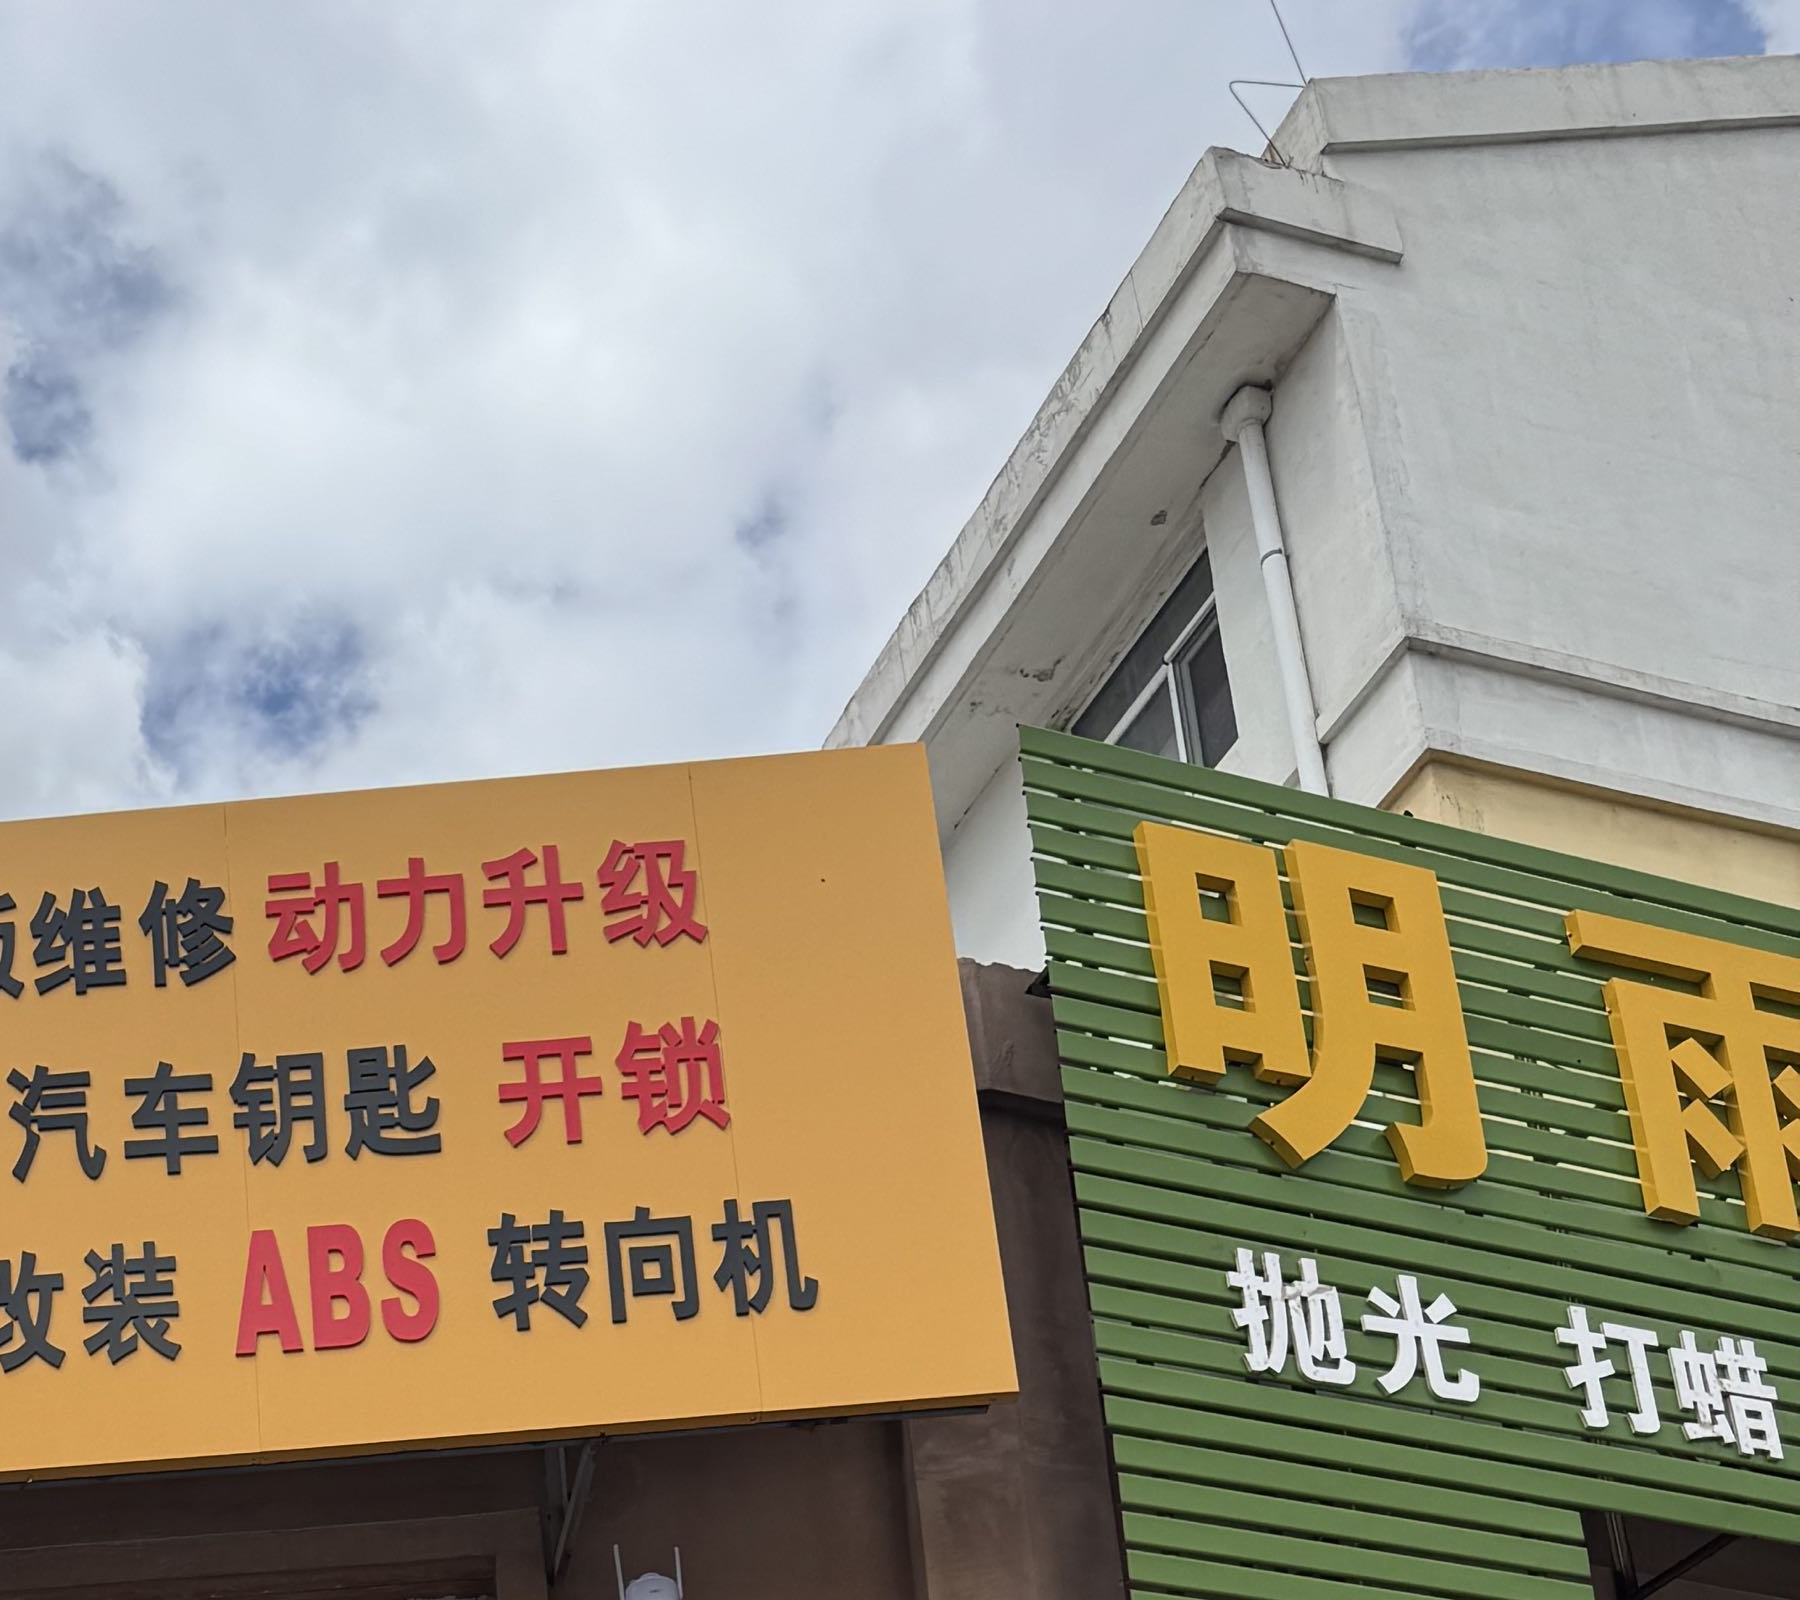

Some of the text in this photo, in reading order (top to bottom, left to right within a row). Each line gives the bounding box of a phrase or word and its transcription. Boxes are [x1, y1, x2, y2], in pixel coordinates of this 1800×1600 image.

[265, 838, 709, 975] 动力升级
[5, 1044, 443, 1184] 汽车钥匙
[497, 1016, 733, 1149] 开锁
[234, 1218, 440, 1358] ABS
[486, 1198, 820, 1333] 转向机
[1226, 1247, 1785, 1461] 抛光 打蜡
